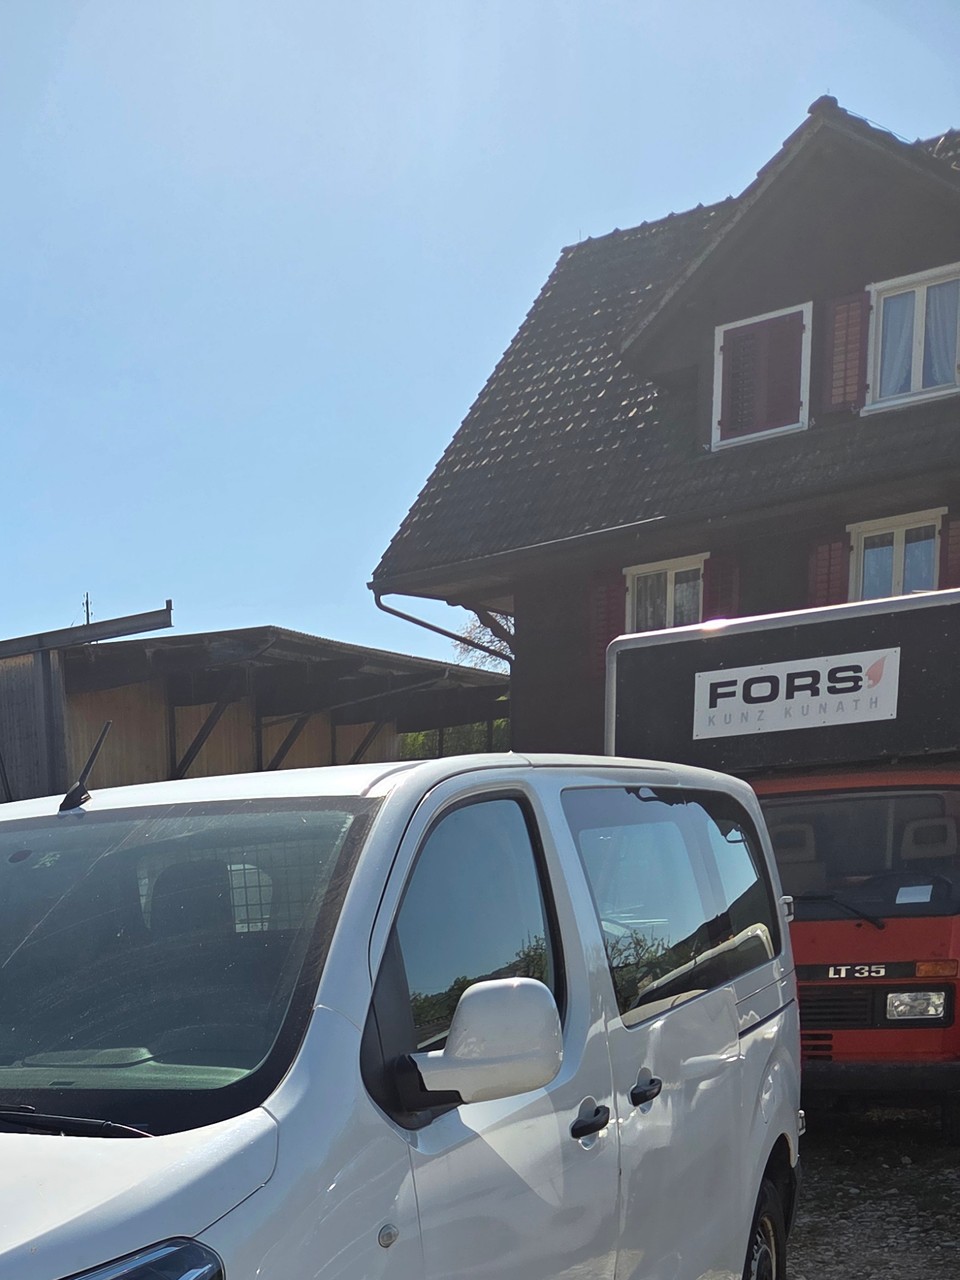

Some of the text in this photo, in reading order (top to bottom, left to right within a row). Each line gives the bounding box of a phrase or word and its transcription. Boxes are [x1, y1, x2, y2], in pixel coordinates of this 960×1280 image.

[708, 664, 863, 709] FORS
[707, 696, 879, 727] KUNZ KUNATH
[828, 964, 886, 978] LT 35
